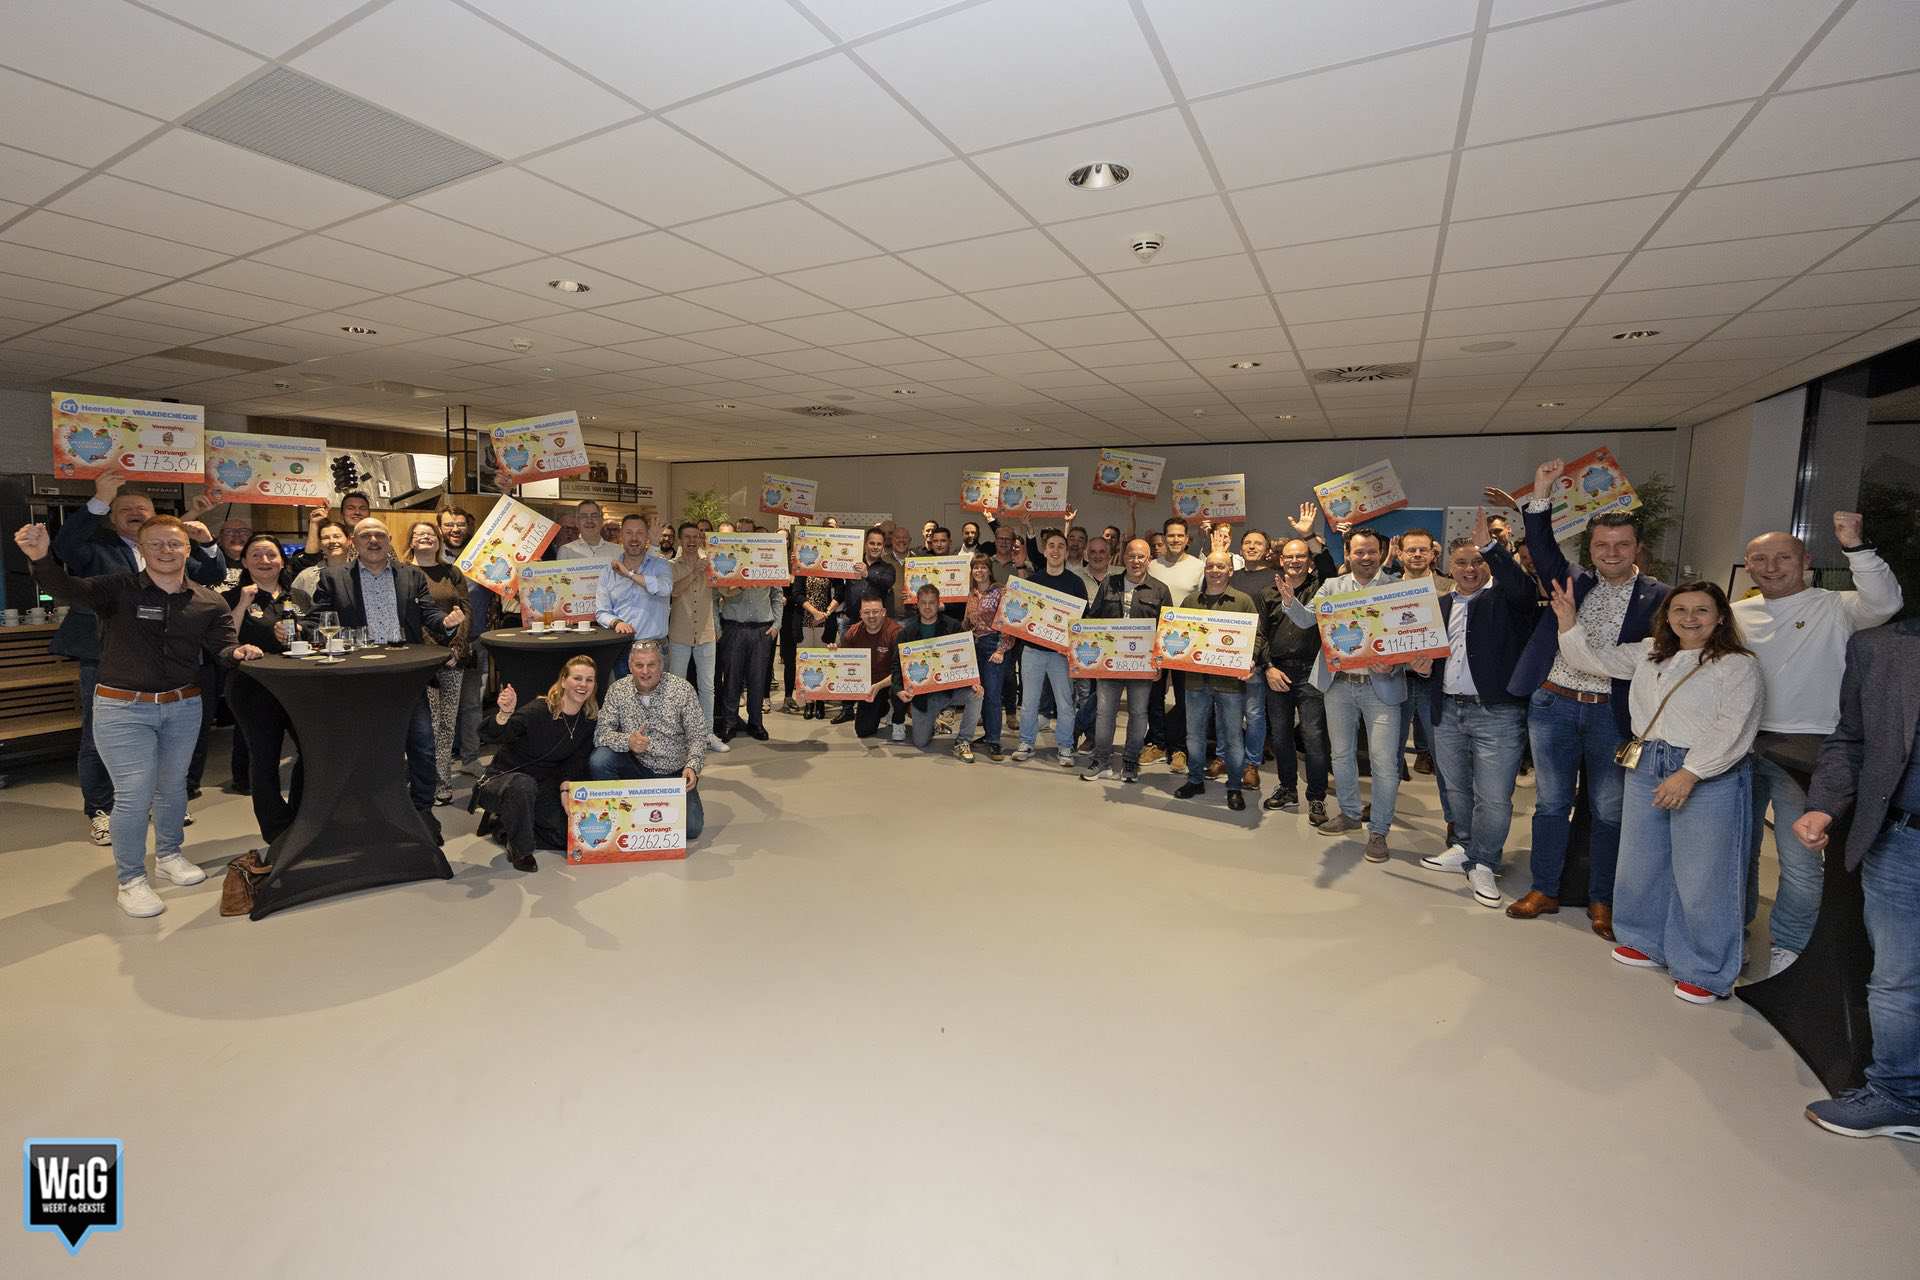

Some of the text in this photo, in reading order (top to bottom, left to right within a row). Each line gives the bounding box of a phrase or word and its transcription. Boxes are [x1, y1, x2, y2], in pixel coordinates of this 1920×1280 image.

[132, 409, 198, 421] WAARDECHEQUE
[590, 789, 623, 798] Heerschap
[628, 787, 681, 796] WAARDECHEQUE
